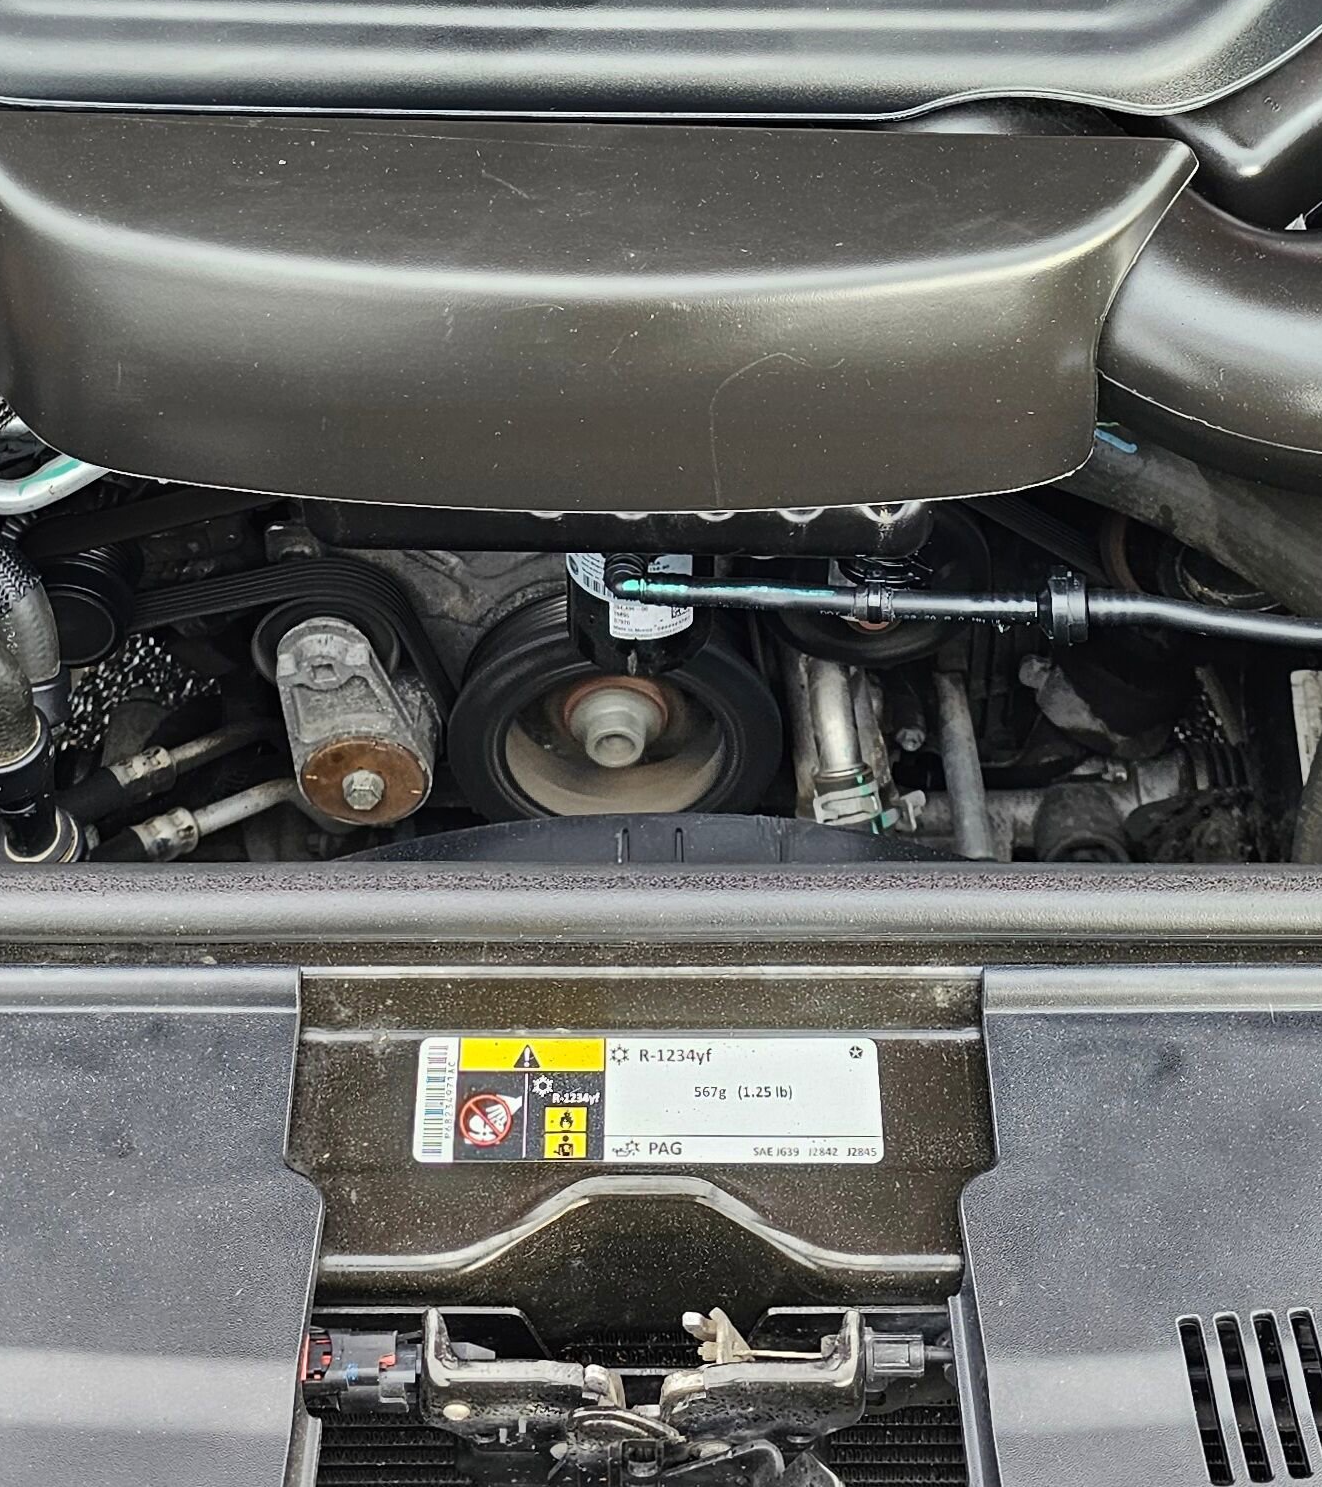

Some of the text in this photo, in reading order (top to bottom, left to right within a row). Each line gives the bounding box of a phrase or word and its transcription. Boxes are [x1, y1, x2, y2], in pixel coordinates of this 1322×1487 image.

[639, 1048, 713, 1066] R-1234yf
[552, 1092, 600, 1106] R-1234yf
[694, 1085, 793, 1100] 567g (1.25 lb)
[649, 1141, 683, 1156] PAG
[753, 1147, 774, 1157] SAE
[776, 1147, 800, 1157] J639
[847, 1147, 878, 1157] J2845
